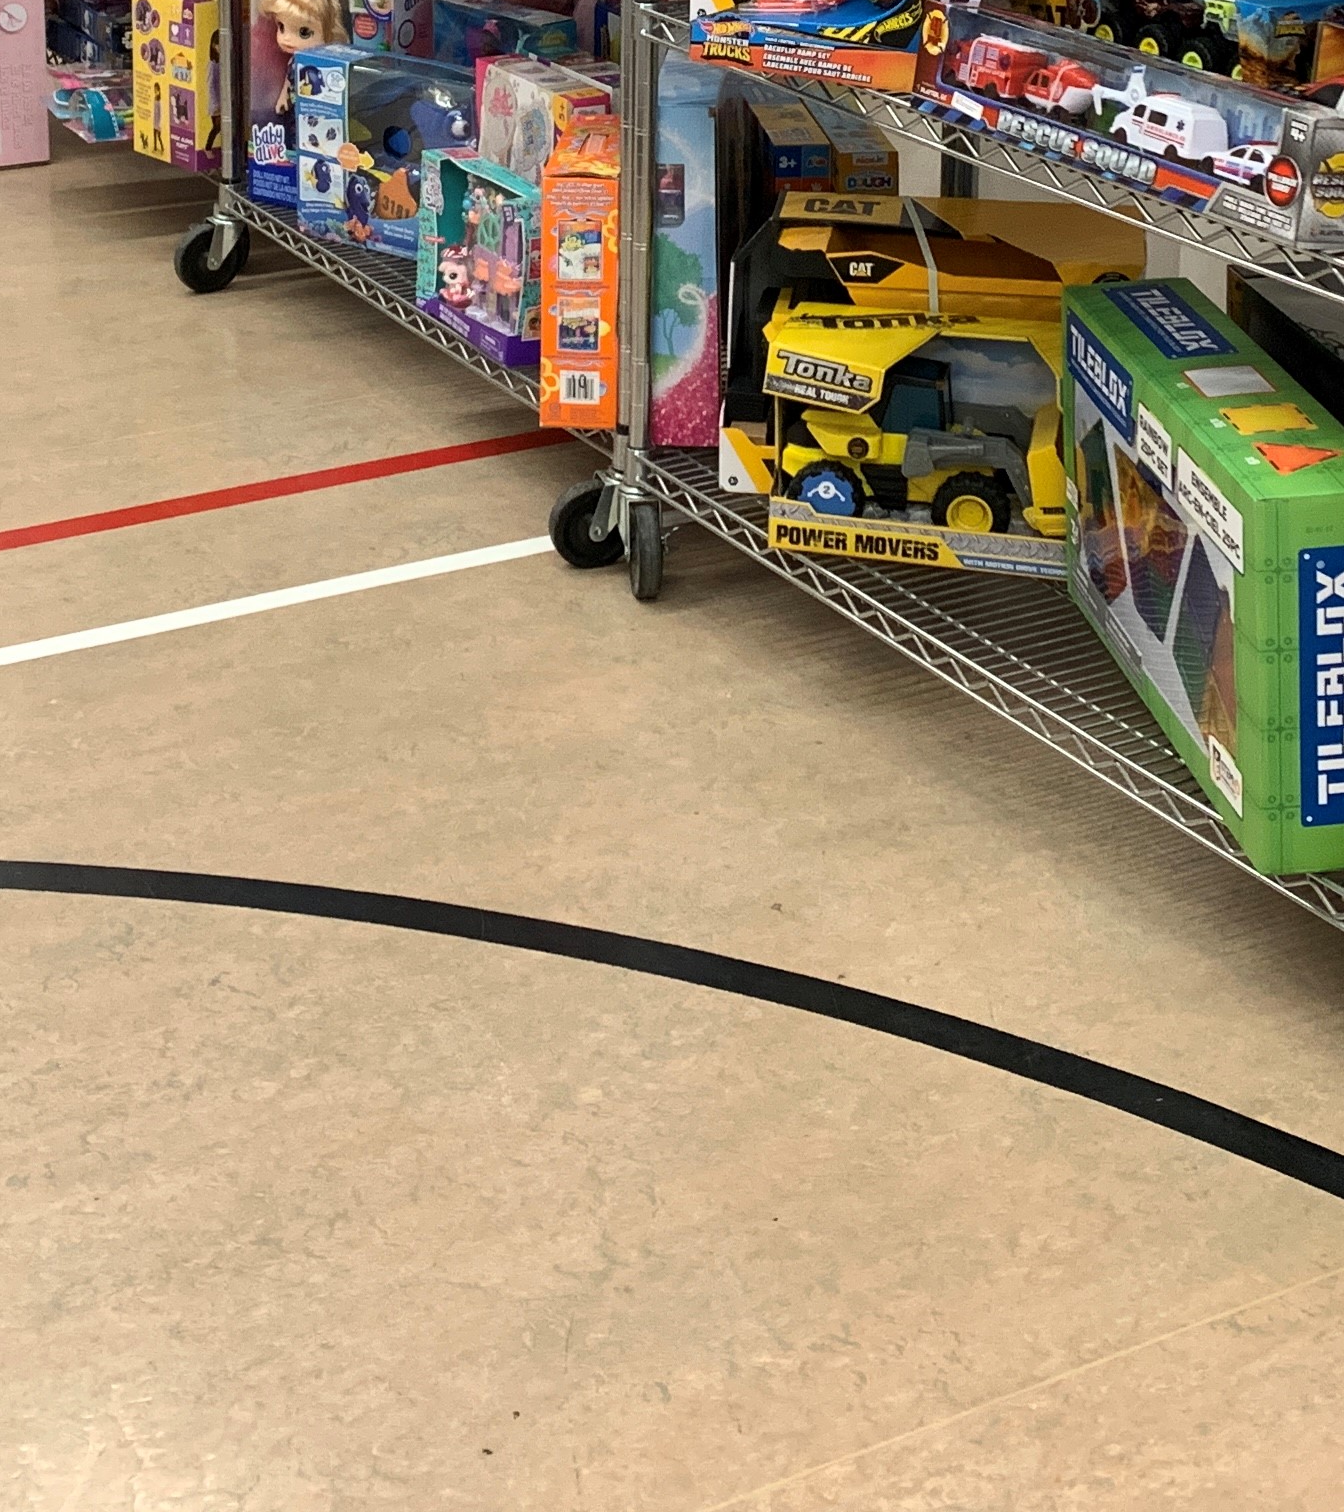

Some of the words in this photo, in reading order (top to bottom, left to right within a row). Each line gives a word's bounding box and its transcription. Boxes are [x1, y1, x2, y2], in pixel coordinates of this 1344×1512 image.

[702, 42, 752, 62] TRUCKS
[252, 123, 285, 149] baby
[997, 108, 1080, 158] RESCUE
[1081, 139, 1157, 185] SQUAD
[255, 142, 287, 163] alive
[778, 155, 798, 169] 3+
[803, 197, 881, 217] CAT
[848, 261, 874, 277] CAT
[1130, 288, 1220, 353] TILEBLOX
[776, 350, 873, 391] Tonka
[1070, 324, 1129, 418] TILEBLOX
[1190, 471, 1229, 522] ENSEMBLE
[776, 523, 848, 553] POWER
[854, 533, 941, 561] MOVERS
